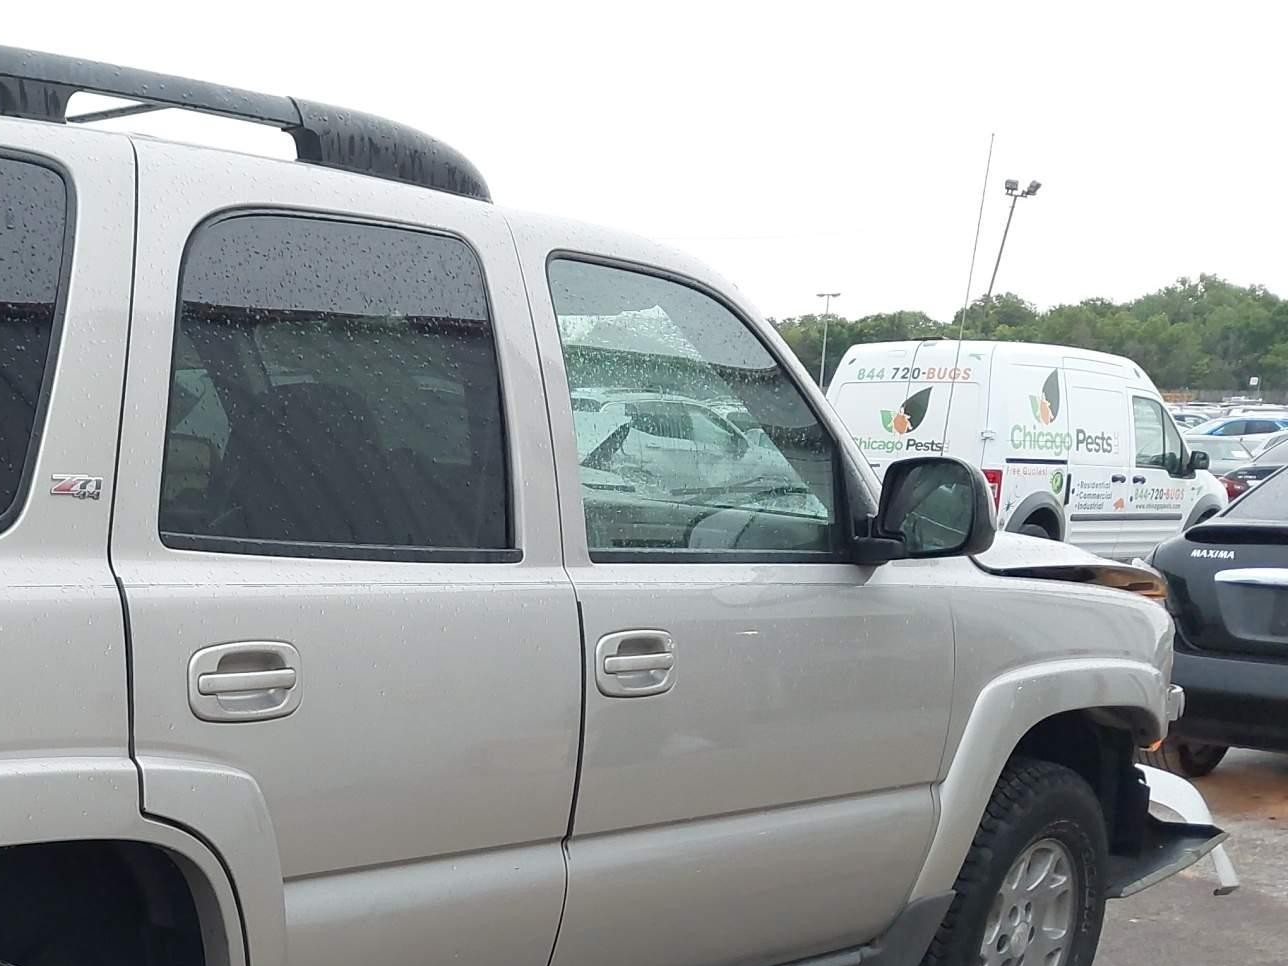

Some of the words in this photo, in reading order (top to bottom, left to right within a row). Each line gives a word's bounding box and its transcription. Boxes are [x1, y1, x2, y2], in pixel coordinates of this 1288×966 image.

[857, 368, 885, 380] 844
[891, 367, 972, 380] 720-BUGS
[906, 438, 942, 452] Pests
[1011, 424, 1072, 456] Chicago
[1076, 429, 1113, 453] Pests
[1007, 466, 1020, 475] Free
[51, 474, 103, 496] Z71
[1079, 491, 1112, 500] Commercial
[1135, 488, 1185, 500] 844-720-BUGS
[1077, 501, 1104, 511] Industrial
[1191, 549, 1235, 559] MAXIMA
